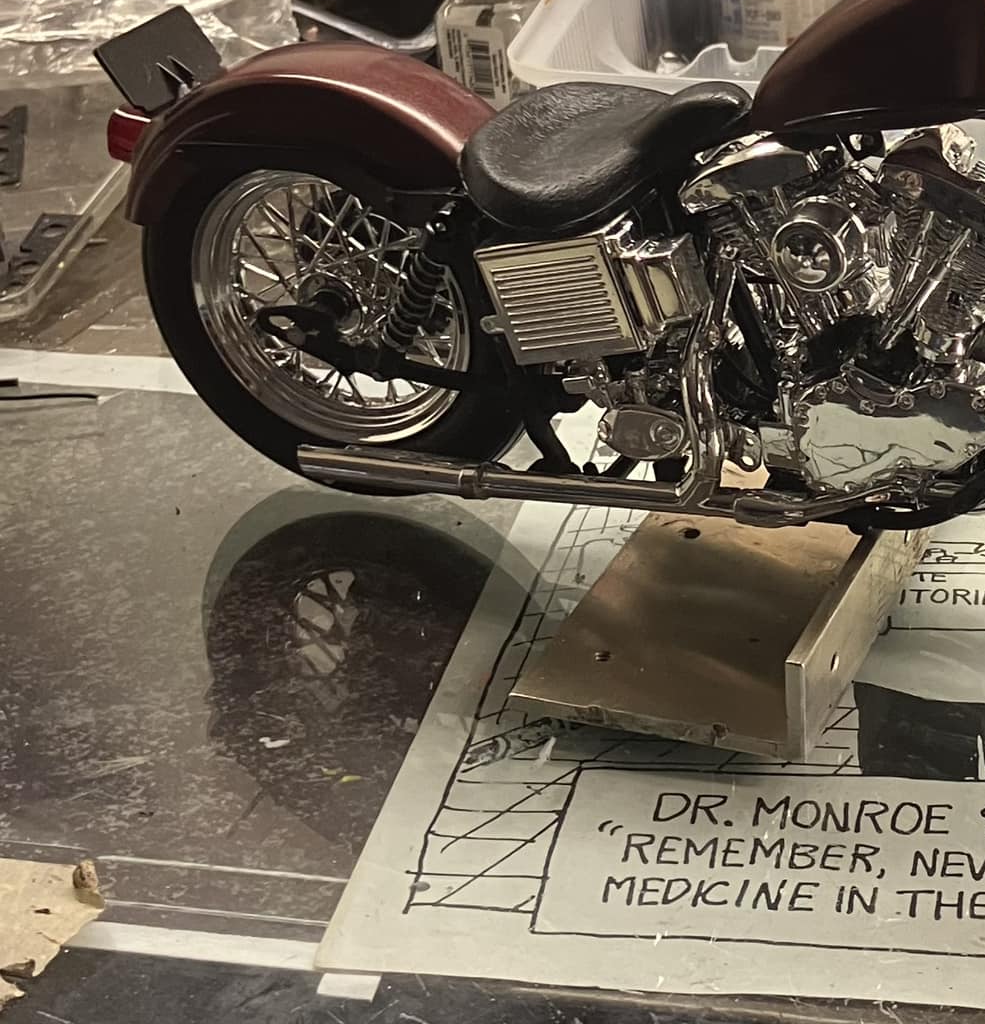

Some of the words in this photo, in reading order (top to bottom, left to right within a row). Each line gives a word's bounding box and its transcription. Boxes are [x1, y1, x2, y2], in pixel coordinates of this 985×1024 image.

[651, 792, 735, 829] DR.
[751, 797, 954, 836] MONROE
[600, 876, 817, 913] MEDICINE
[835, 886, 879, 915] IN
